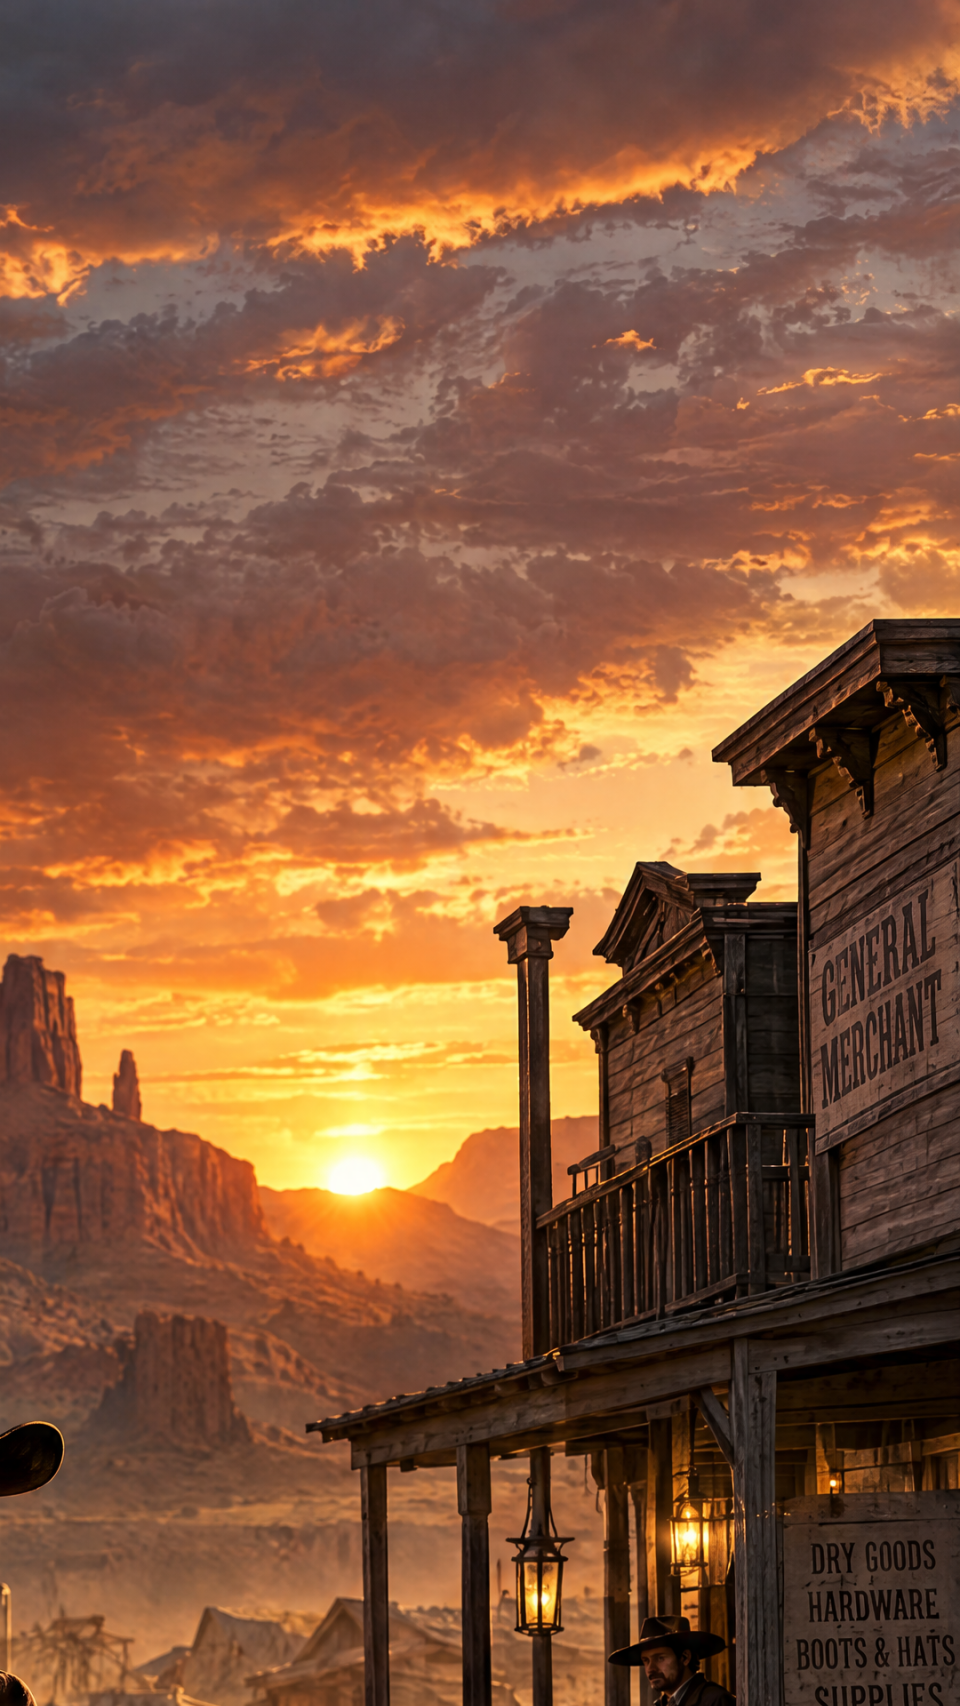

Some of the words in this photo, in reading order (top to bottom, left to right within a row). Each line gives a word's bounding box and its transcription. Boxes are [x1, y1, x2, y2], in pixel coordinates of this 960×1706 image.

[822, 889, 936, 1027] GENERAL
[820, 969, 942, 1110] MERCHANT
[811, 1542, 855, 1575] DRY
[865, 1539, 936, 1573] GOODS
[807, 1588, 940, 1623] HARDWARE
[796, 1637, 868, 1670] BOOTS
[874, 1637, 890, 1668] &
[897, 1634, 956, 1667] HATS
